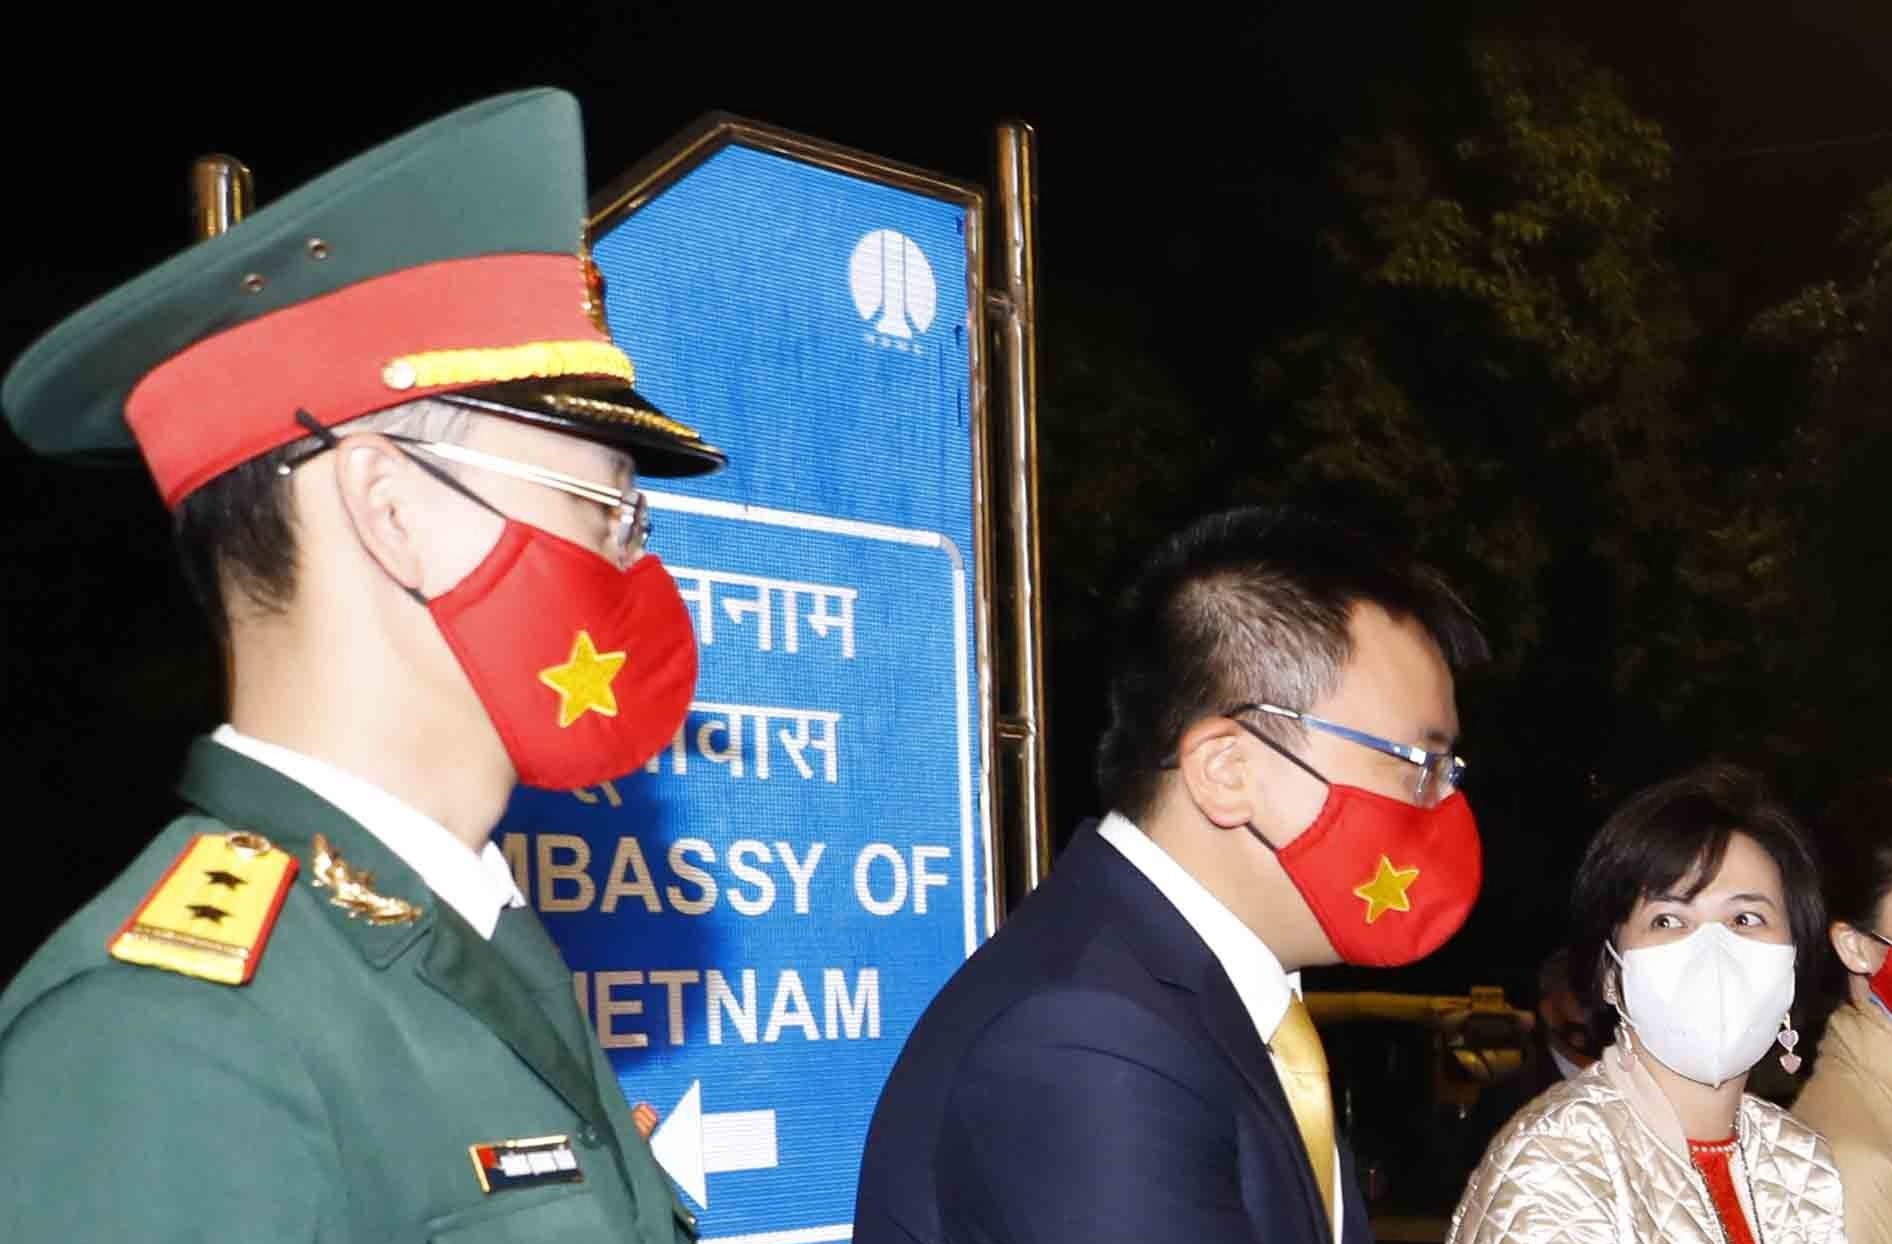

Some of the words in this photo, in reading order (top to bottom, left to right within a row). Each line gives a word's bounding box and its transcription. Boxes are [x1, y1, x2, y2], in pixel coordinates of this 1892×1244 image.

[502, 832, 826, 917] BASSY
[853, 843, 951, 917] OF
[573, 967, 881, 1050] ETNAM
